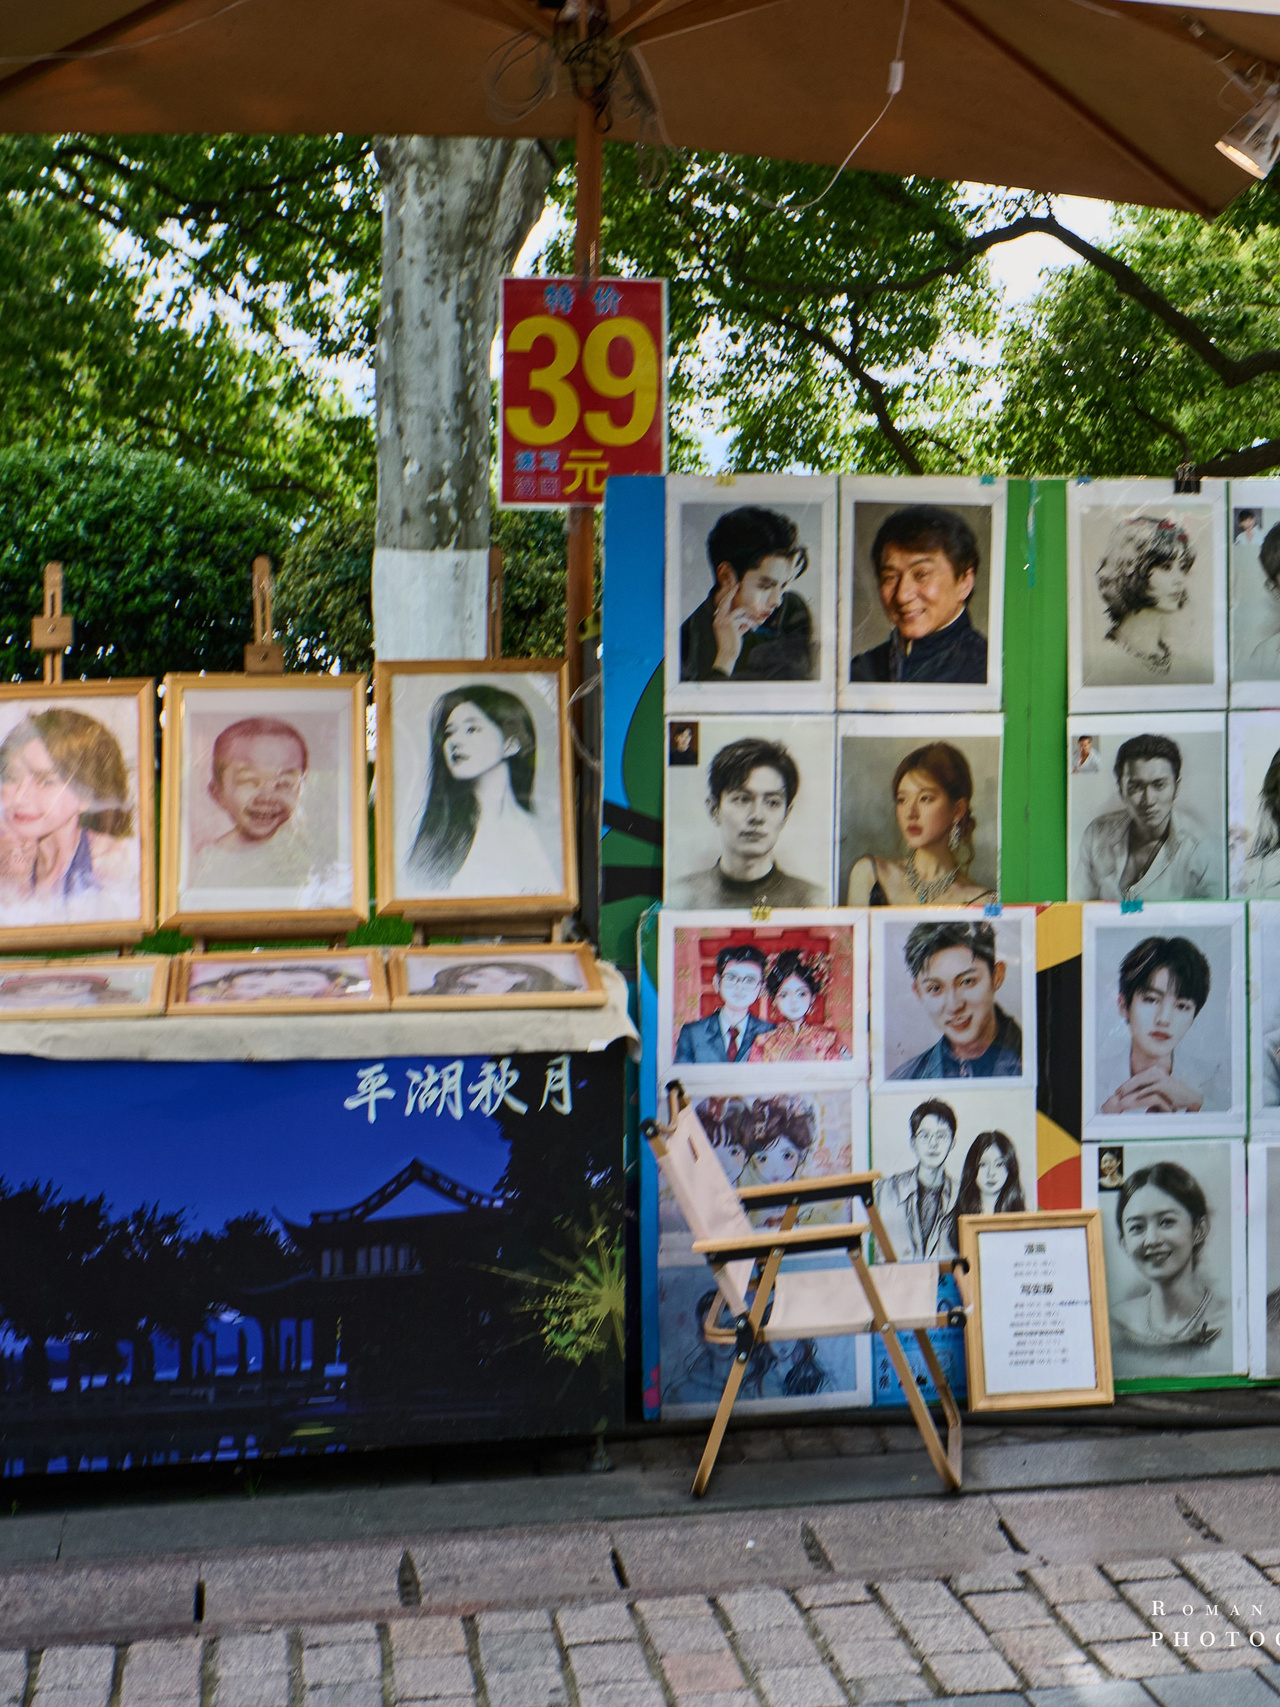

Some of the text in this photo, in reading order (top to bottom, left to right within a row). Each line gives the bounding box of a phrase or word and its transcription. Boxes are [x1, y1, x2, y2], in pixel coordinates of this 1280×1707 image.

[543, 283, 624, 316] 特价
[504, 314, 659, 447] 39
[562, 449, 610, 495] 元
[343, 1053, 573, 1124] 平湖秋月
